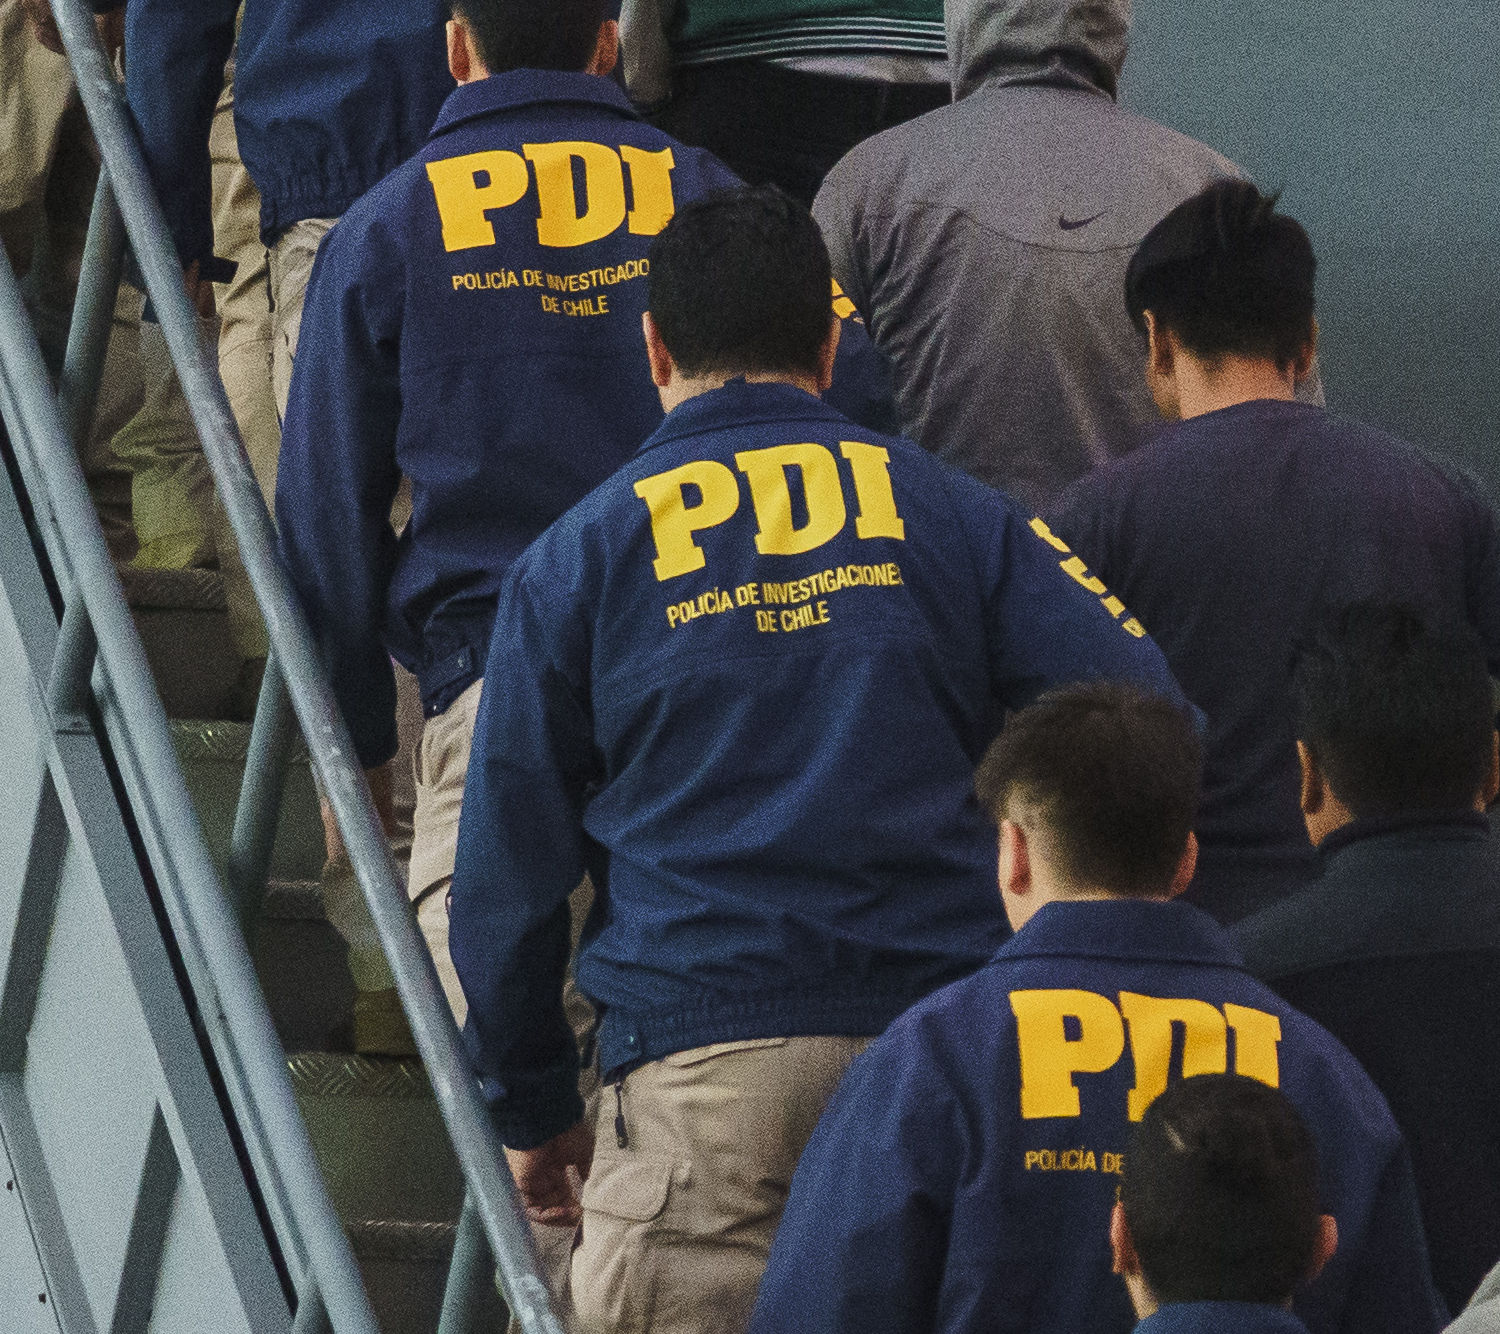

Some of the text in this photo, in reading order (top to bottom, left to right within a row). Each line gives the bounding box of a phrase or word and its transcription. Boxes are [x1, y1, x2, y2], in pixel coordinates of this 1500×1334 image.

[425, 140, 676, 252] PDI
[452, 258, 650, 293] POLICÍA DE INVESTIGACIO
[541, 294, 610, 317] DE CHILE
[634, 440, 905, 581] PDI
[666, 586, 734, 629] POLICÍA
[734, 582, 761, 608] DE
[755, 600, 831, 633] DE CHILE
[1008, 988, 1282, 1123] PDI
[1024, 1147, 1125, 1175] POLICÍA DE
